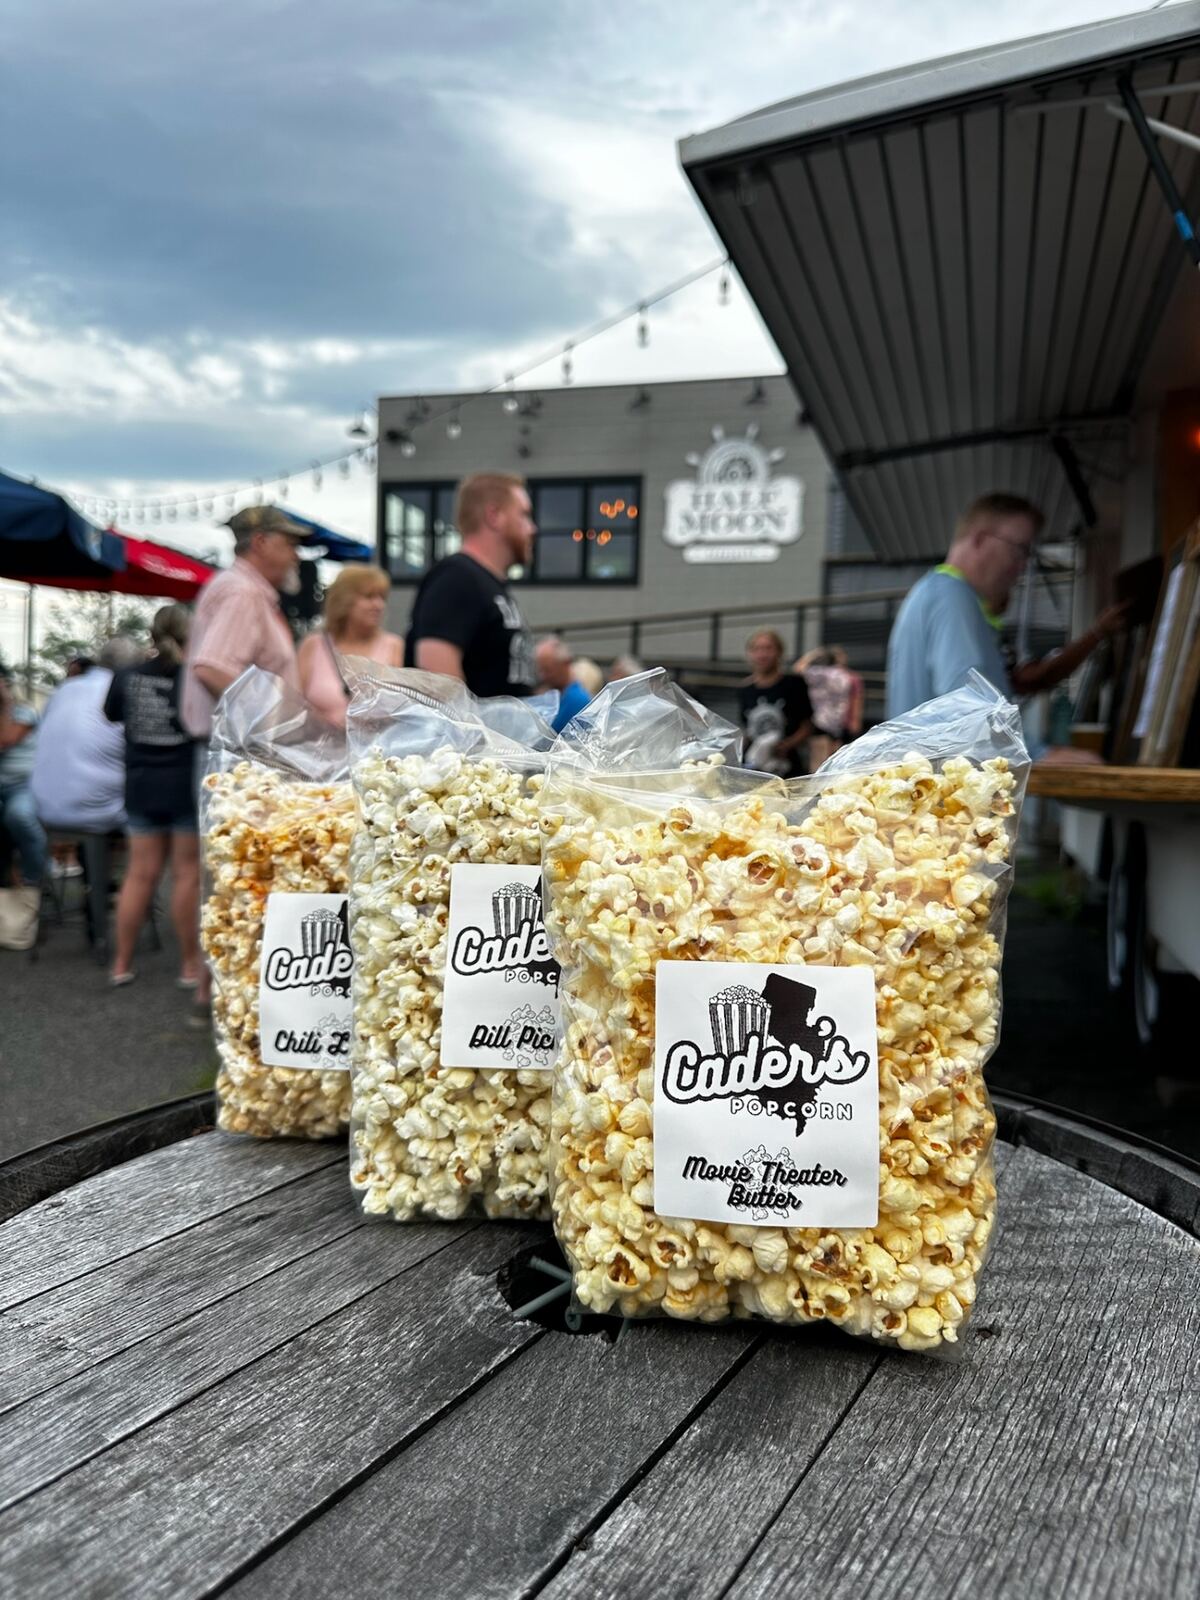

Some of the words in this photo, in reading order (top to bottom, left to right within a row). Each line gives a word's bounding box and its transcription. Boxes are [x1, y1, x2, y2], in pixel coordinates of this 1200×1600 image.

[690, 489, 783, 511] HALF
[679, 511, 788, 536] MOON
[452, 918, 552, 976] Cade
[265, 941, 353, 990] Cade
[505, 969, 557, 984] POPC
[275, 1029, 322, 1054] Chili
[469, 1024, 512, 1050] Dill
[516, 1024, 555, 1050] Pic
[662, 1016, 870, 1104] Cader's
[730, 1098, 853, 1121] POPCORN
[682, 1156, 753, 1181] Movie
[760, 1161, 848, 1187] Theater
[727, 1184, 803, 1210] Butter
